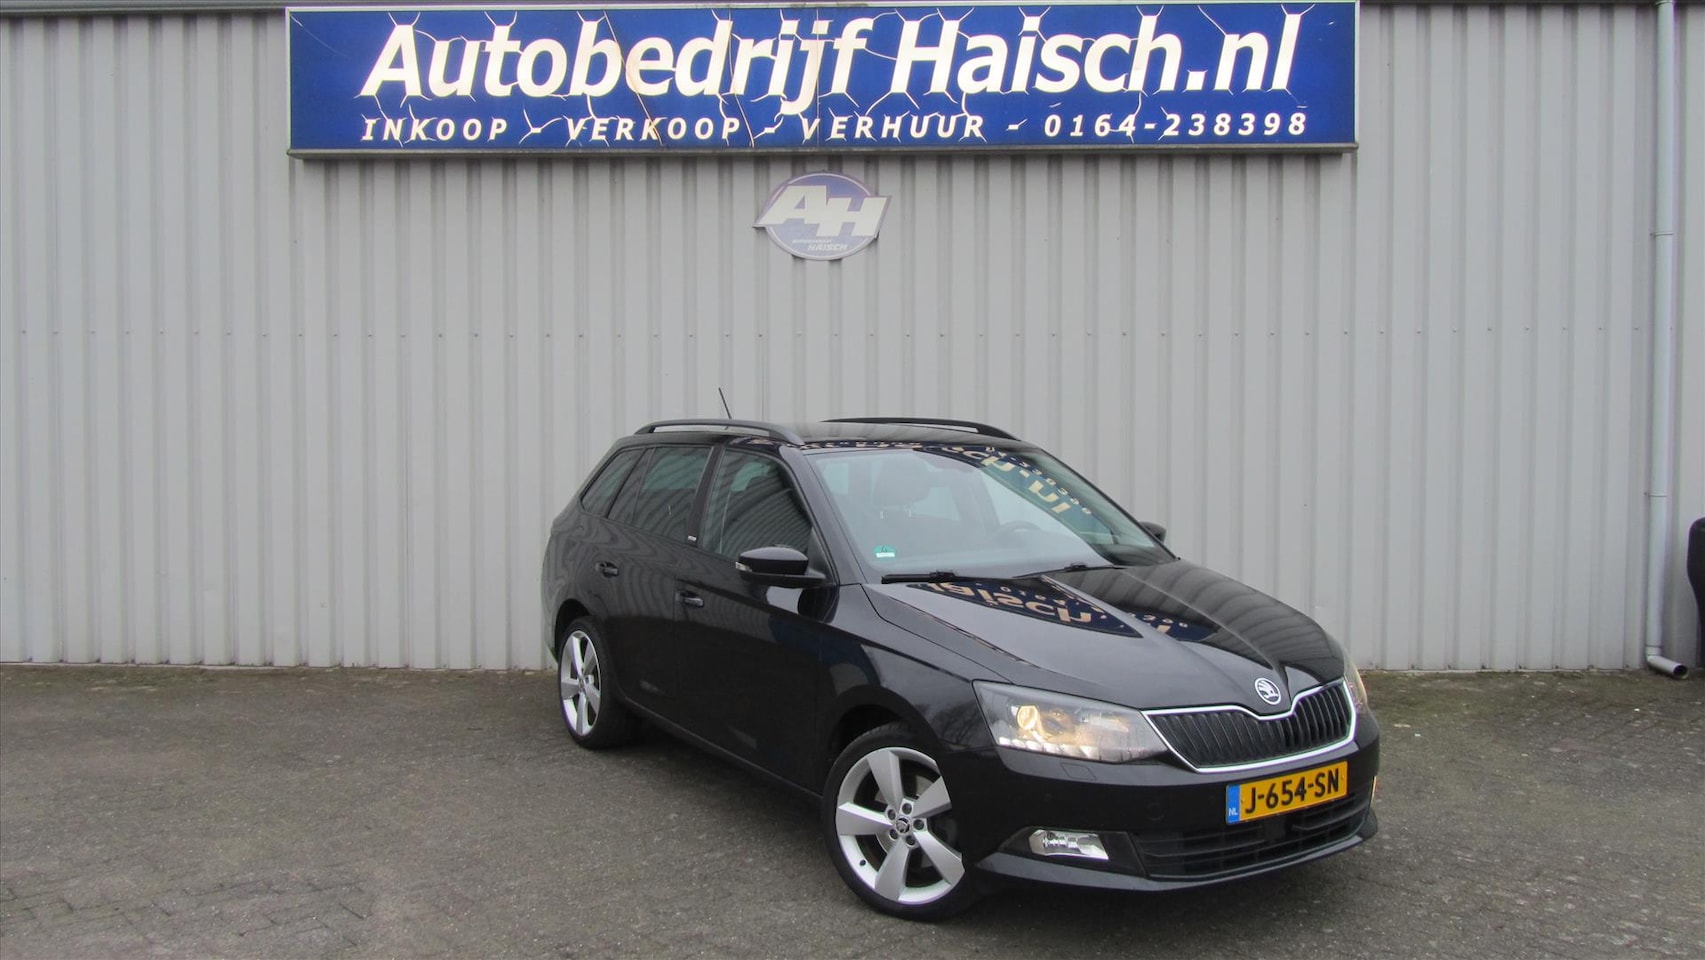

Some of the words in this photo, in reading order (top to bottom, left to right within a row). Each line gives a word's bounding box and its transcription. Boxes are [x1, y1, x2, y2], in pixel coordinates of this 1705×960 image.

[359, 19, 874, 116] Autobedrijf
[888, 13, 1304, 94] Haisch.nl
[361, 117, 509, 142] INKOOP
[566, 117, 741, 141] VERKOOP
[801, 114, 985, 142] VERHUUR
[1044, 112, 1307, 138] 0164-238398
[757, 184, 888, 237] AH
[807, 243, 848, 251] HAISCH
[1245, 768, 1340, 814] J-654-SN
[1228, 807, 1239, 817] NL
